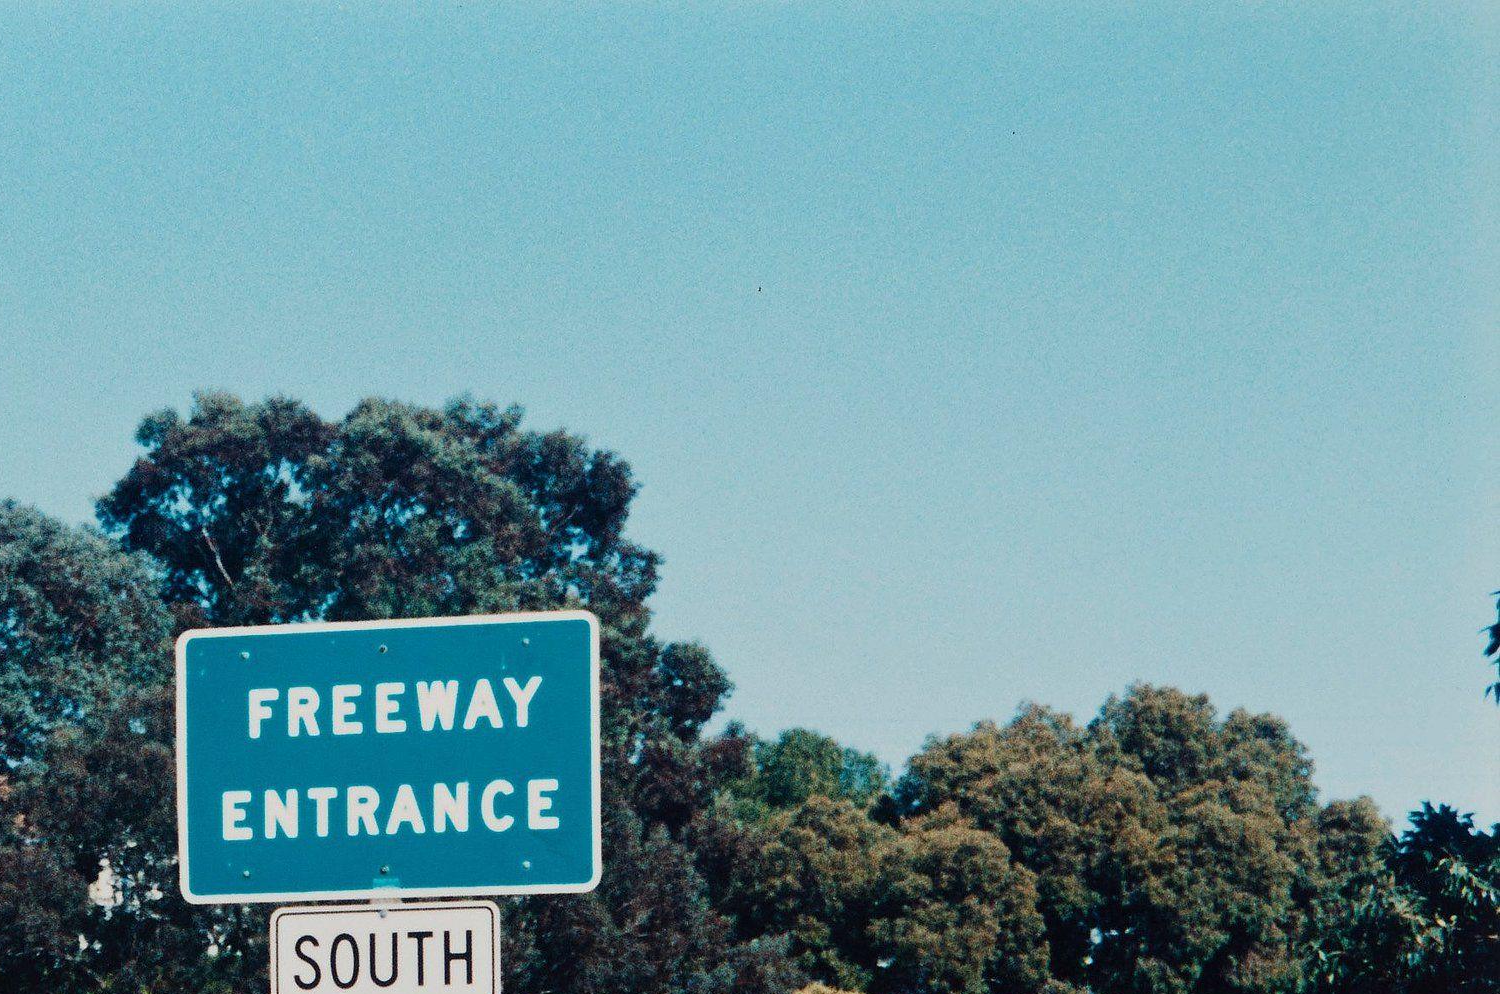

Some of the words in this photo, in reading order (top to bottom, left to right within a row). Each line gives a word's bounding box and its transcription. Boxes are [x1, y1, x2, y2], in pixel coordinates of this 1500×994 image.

[248, 676, 543, 739] FREEWAY
[222, 779, 560, 841] ENTRANCE
[294, 930, 473, 990] SOUTH
